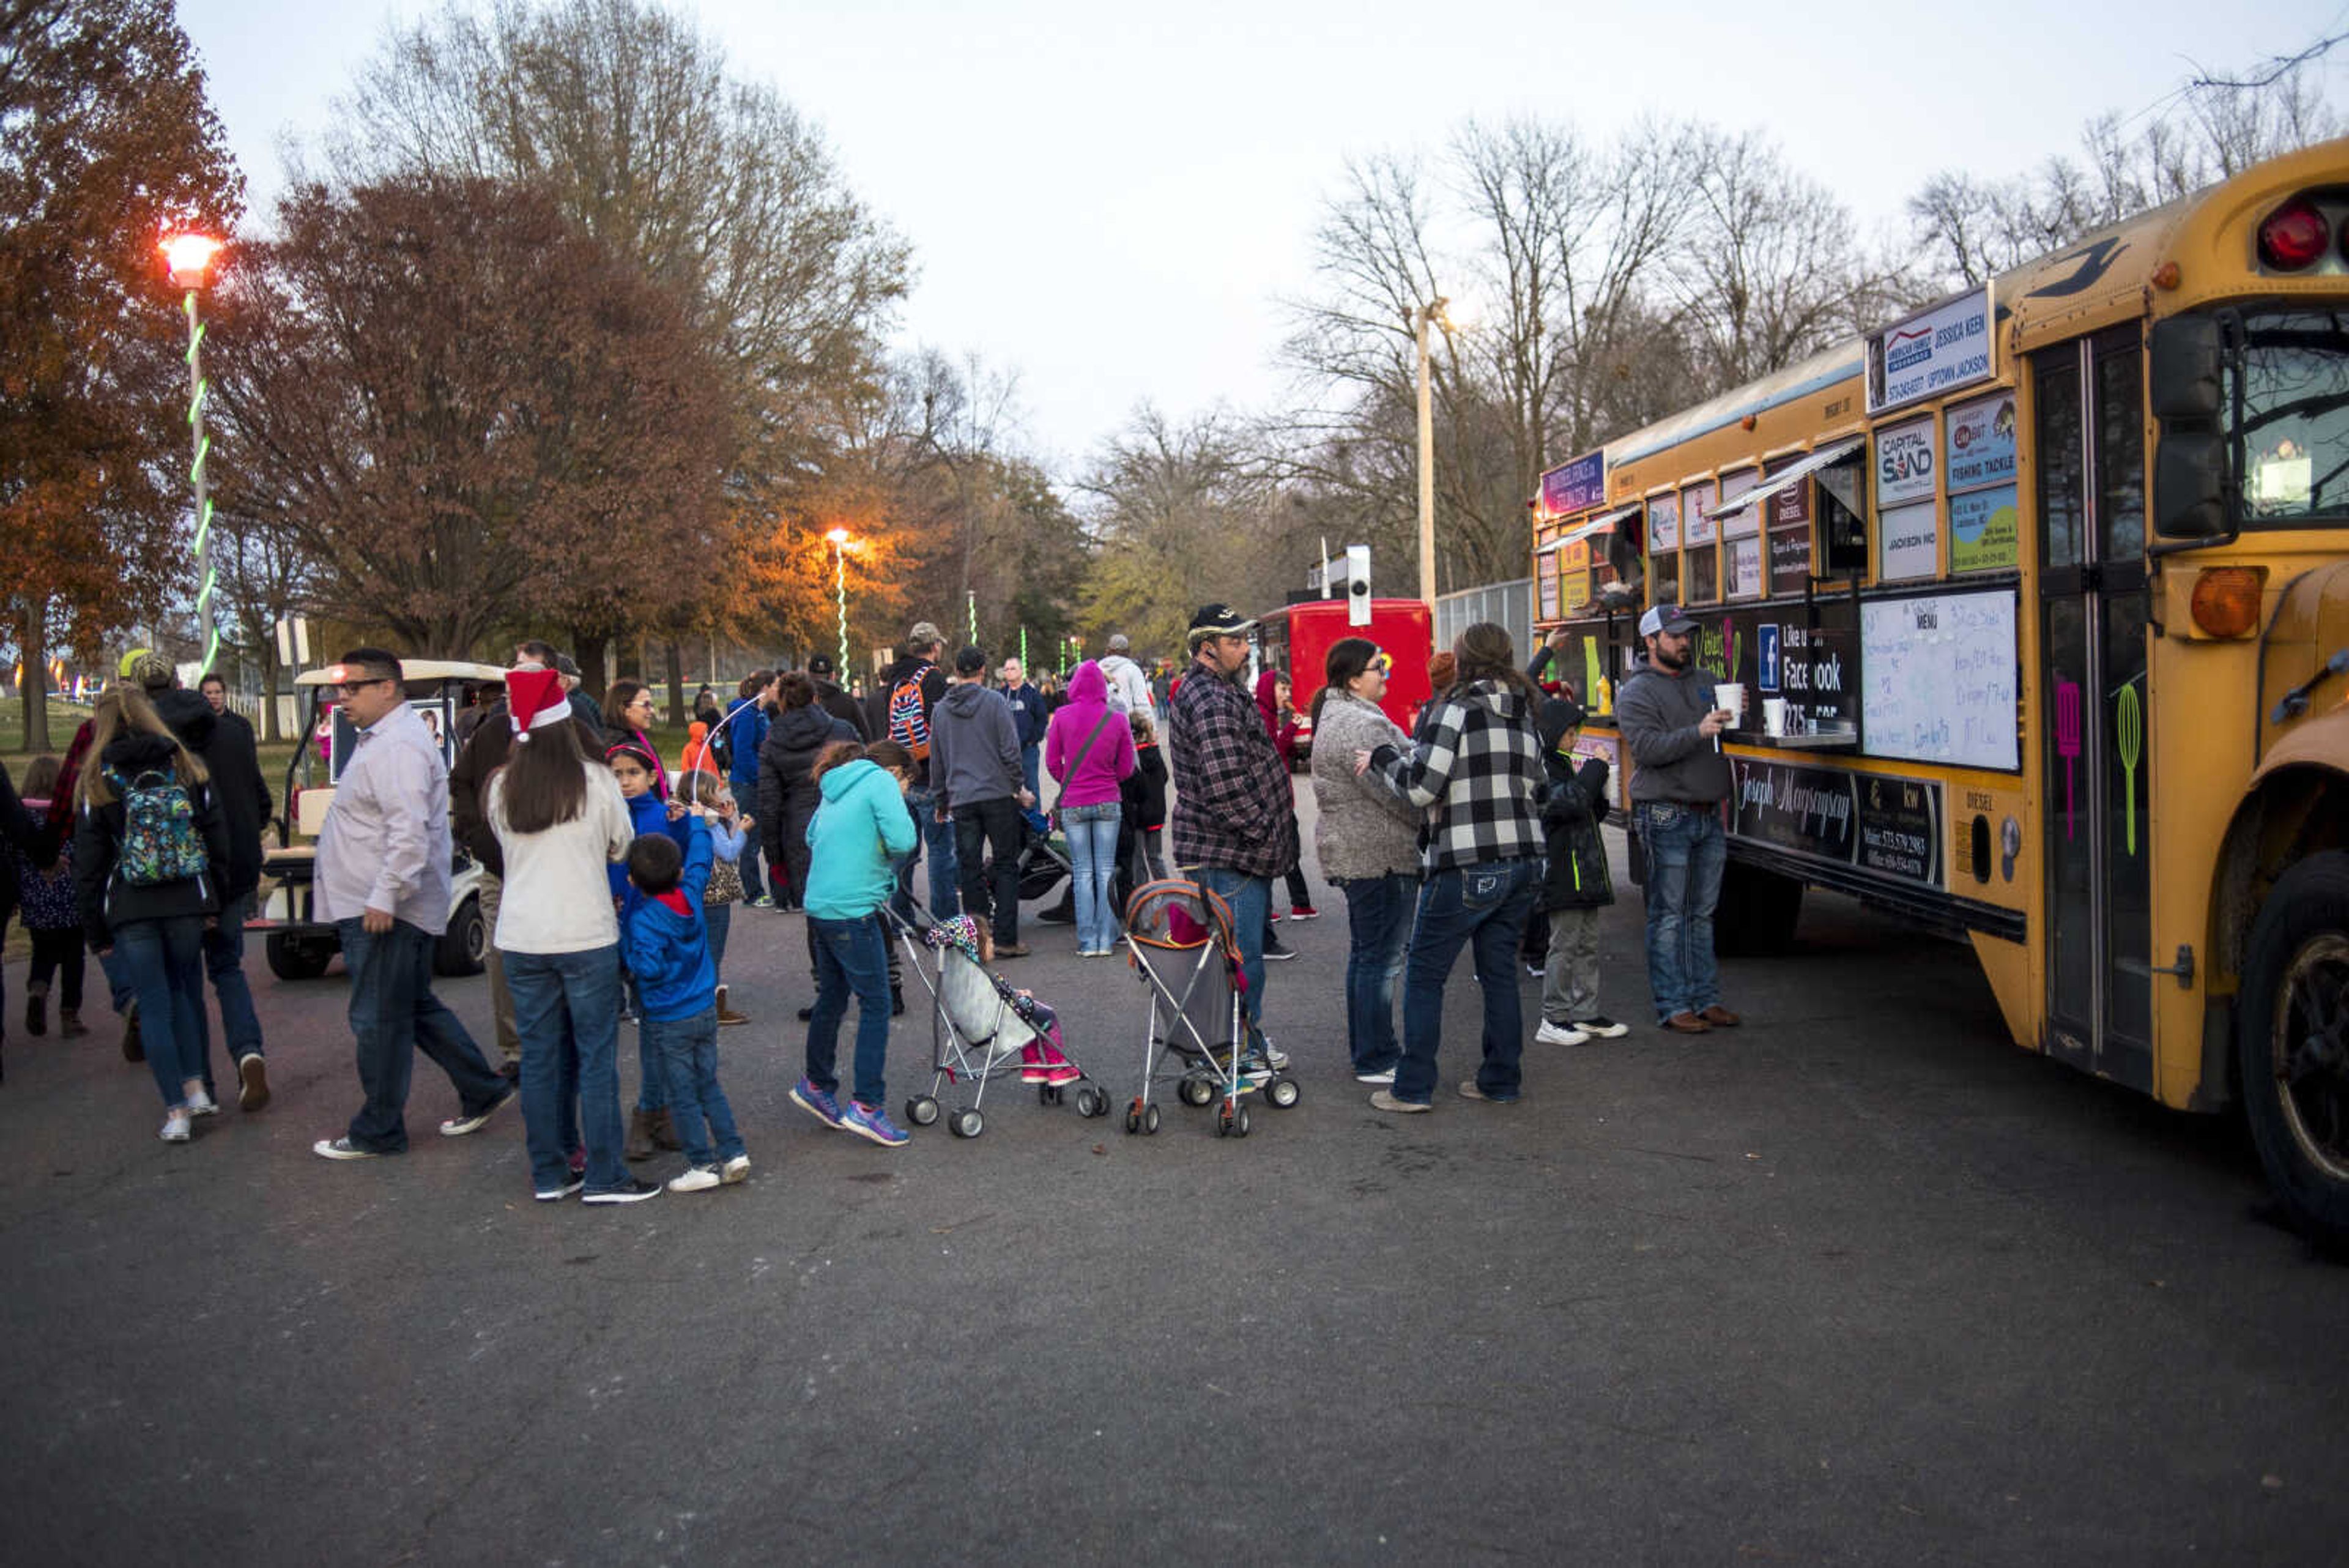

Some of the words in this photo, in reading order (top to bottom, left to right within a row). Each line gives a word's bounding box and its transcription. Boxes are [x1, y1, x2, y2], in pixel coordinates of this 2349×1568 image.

[1935, 321, 1962, 349] JESSICA
[1965, 313, 1984, 333] KEEN
[1888, 343, 1912, 360] AMERICAN
[1913, 336, 1932, 352] FAMILY
[1928, 364, 1955, 388] UPTOWN
[1957, 354, 1988, 378] JACKSON
[1883, 430, 1926, 455] CAPITAL
[1883, 448, 1932, 483] SAND
[1953, 463, 1982, 482] FISHING
[1985, 455, 2013, 474] TACKLE
[1888, 535, 1922, 551] JACKSON
[1783, 623, 1800, 647] Like
[1917, 614, 1937, 630] MENU
[1783, 652, 1841, 692] Faceook
[1739, 763, 1773, 822] Joseph
[1904, 782, 1919, 809] kw
[1967, 791, 1993, 811] DIESEL
